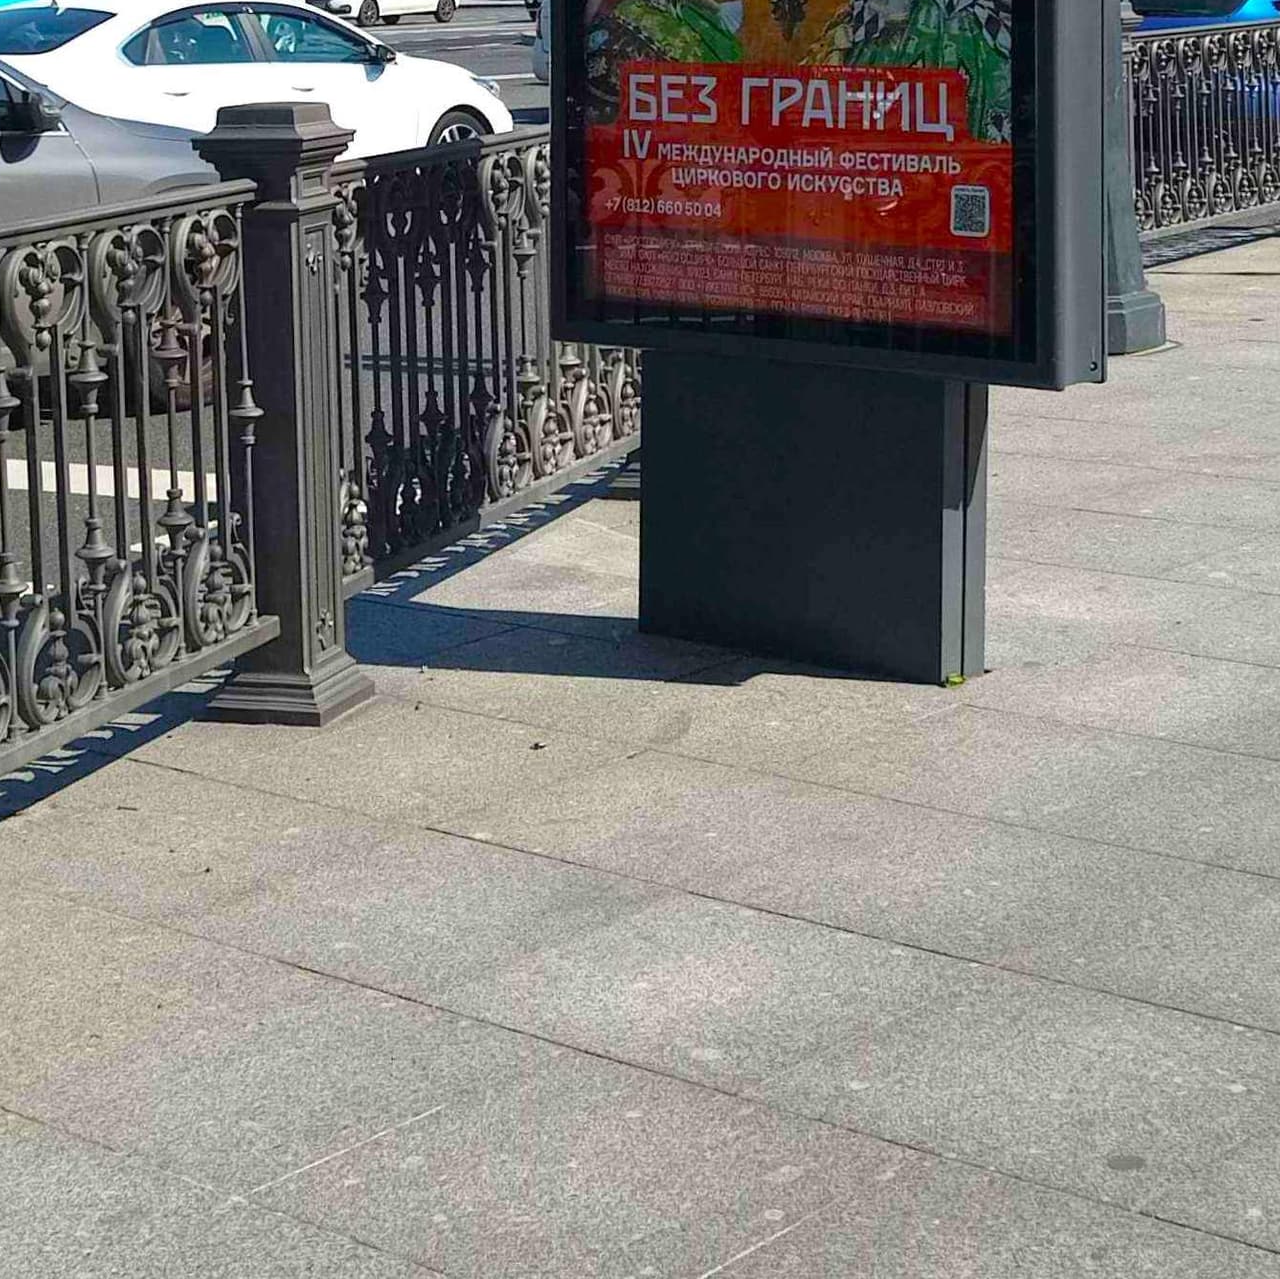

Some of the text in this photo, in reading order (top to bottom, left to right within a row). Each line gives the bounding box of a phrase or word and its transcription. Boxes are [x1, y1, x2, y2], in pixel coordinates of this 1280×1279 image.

[629, 73, 954, 142] БЕЗ ГРАНИЦ
[623, 129, 962, 175] IV МЕЖДУНАРОДНЫЙ ФЕСТИВАЛЬ
[672, 167, 904, 198] ЦИРКОВОГО ИСКУССТВА
[657, 200, 683, 216] 660
[684, 203, 704, 217] 50
[704, 205, 722, 218] 04
